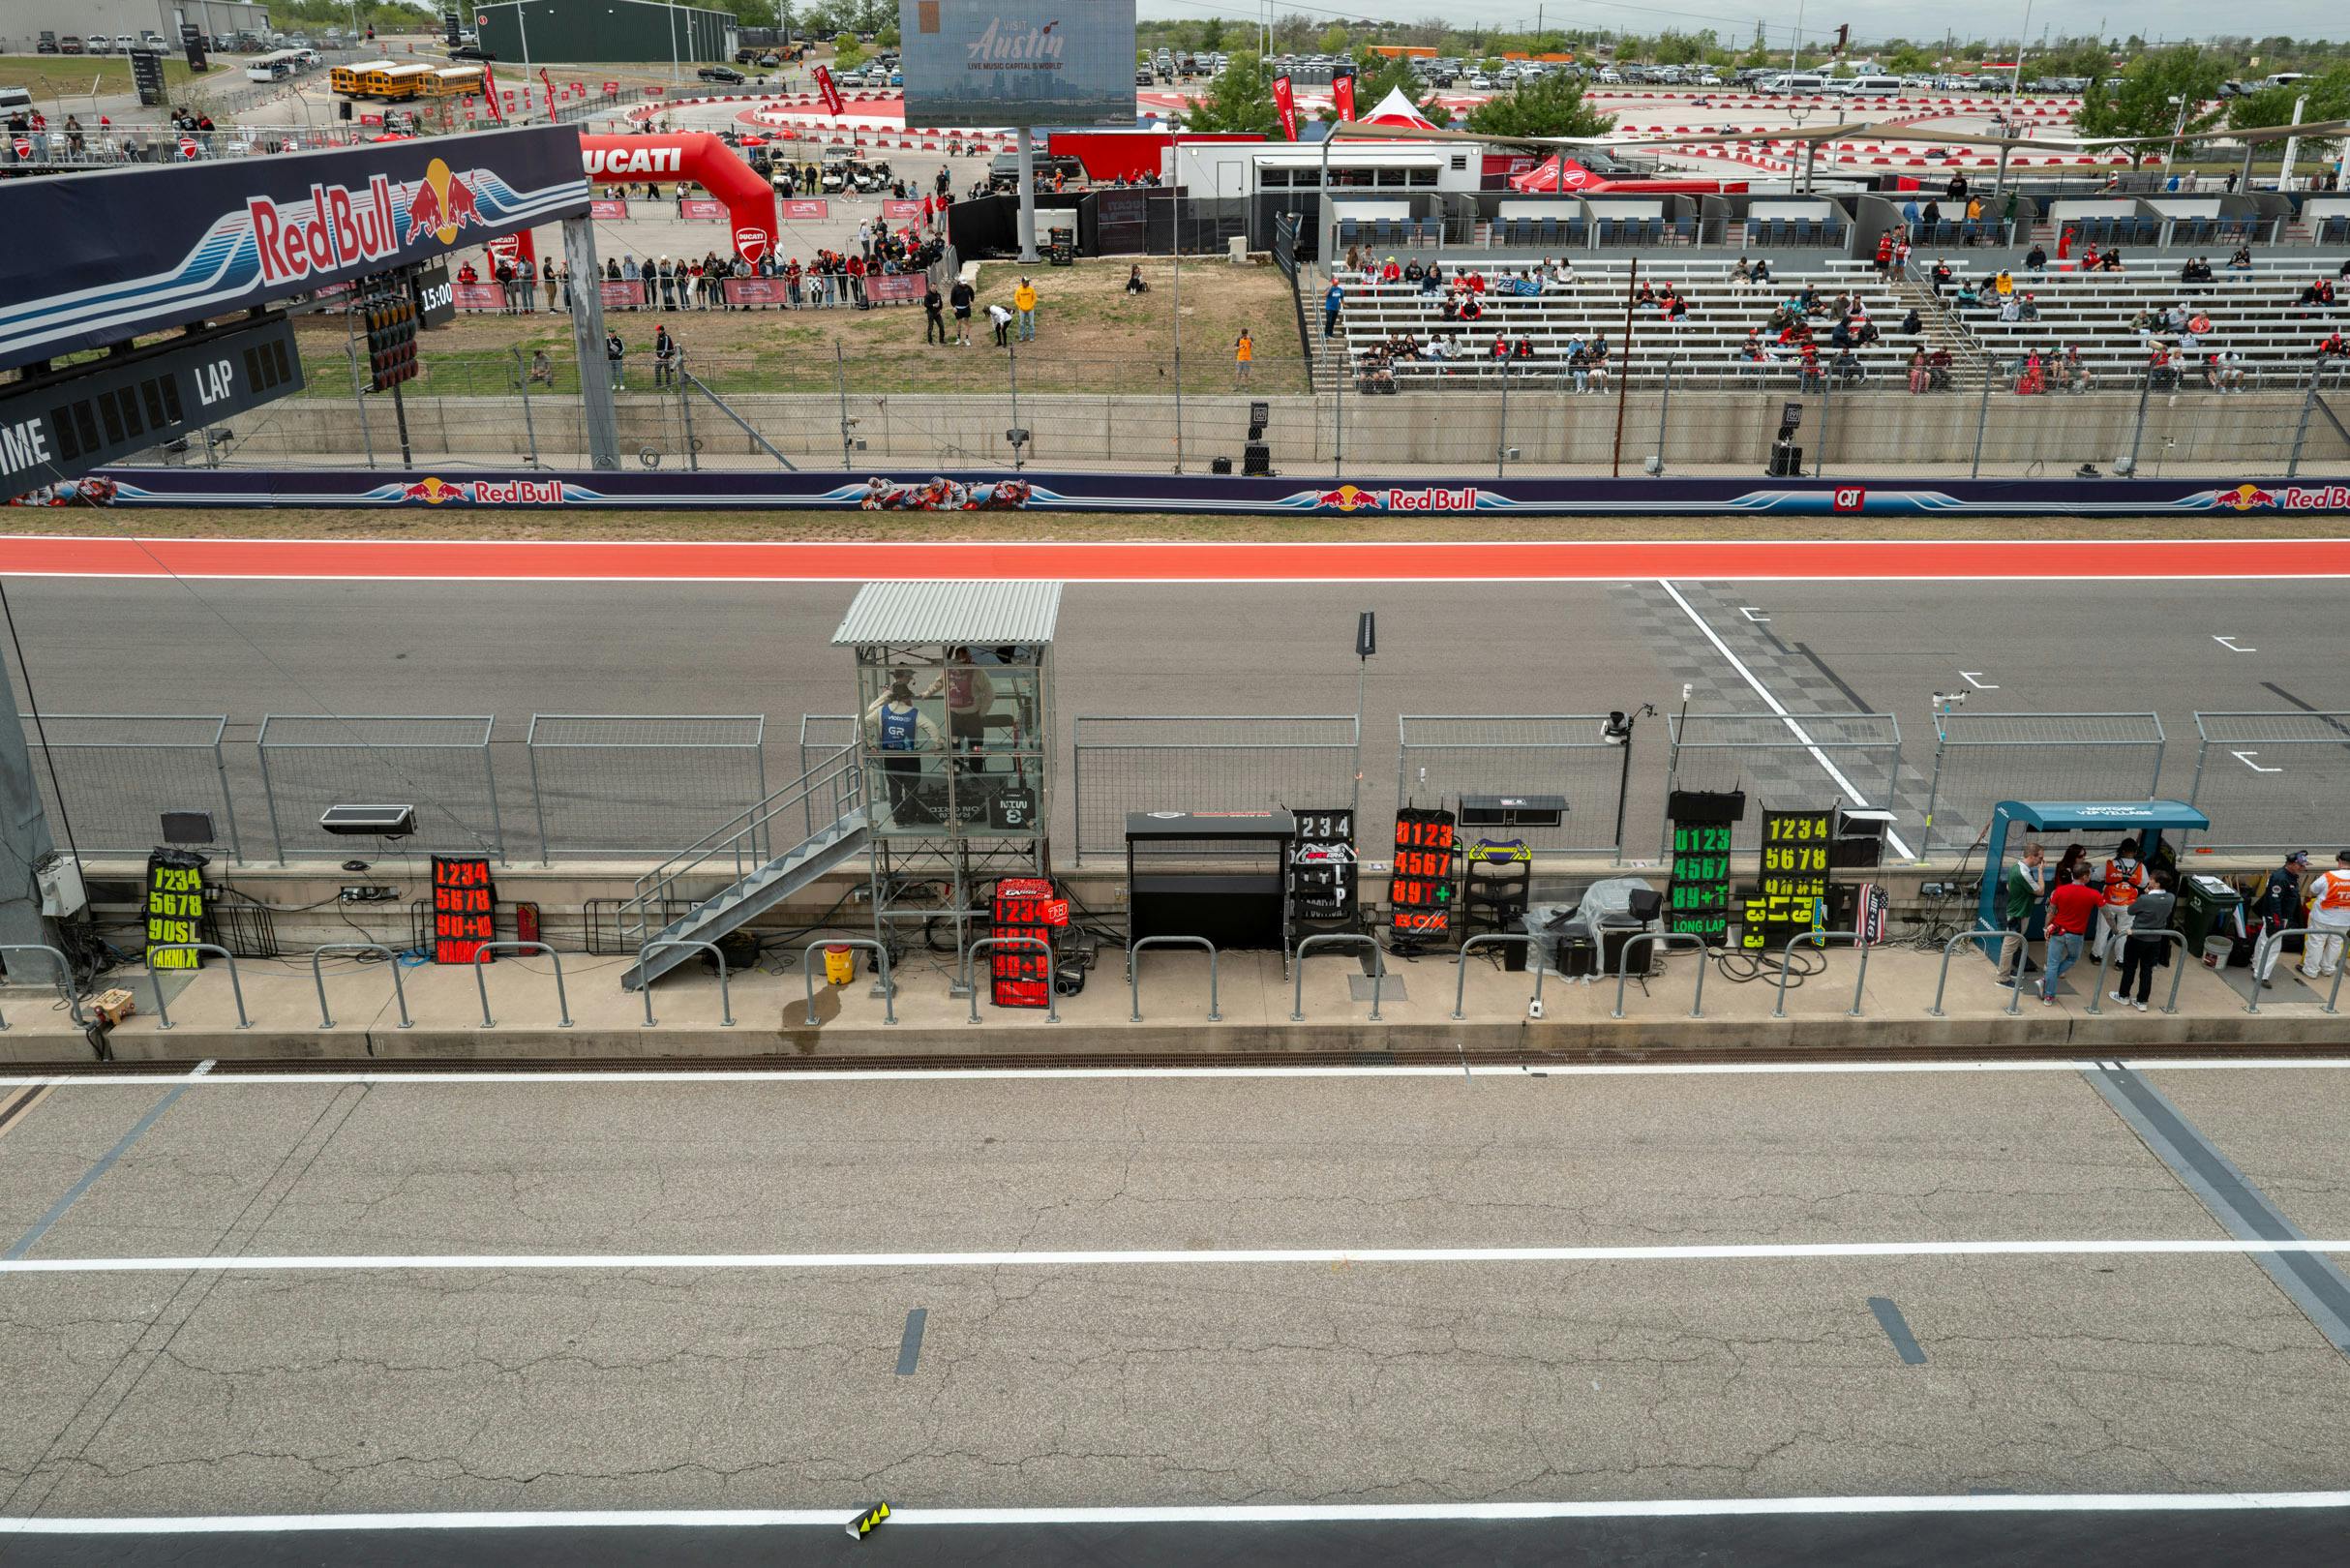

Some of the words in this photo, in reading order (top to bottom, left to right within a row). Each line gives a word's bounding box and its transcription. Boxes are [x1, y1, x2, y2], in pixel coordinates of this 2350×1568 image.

[967, 16, 1064, 60] Austin
[823, 83, 838, 111] PARKING
[582, 148, 681, 174] UCATI
[250, 187, 337, 281] Red
[328, 177, 397, 264] Bull
[421, 282, 453, 313] 15:00
[195, 359, 233, 406] LAP
[473, 480, 520, 503] Red
[520, 480, 564, 503] Bull
[1388, 487, 1432, 511] Red
[1433, 487, 1477, 511] Bull
[1837, 490, 1860, 507] QT
[2283, 486, 2333, 510] Red
[889, 726, 905, 736] GR
[1000, 800, 1028, 809] MIN
[1007, 809, 1022, 824] 3
[1396, 821, 1454, 847] 0123
[1674, 828, 1732, 852] 0123
[1769, 819, 1827, 840] 1234
[1394, 852, 1450, 877] 4567
[1673, 858, 1729, 881] 4567
[1765, 848, 1826, 871] 5678
[155, 867, 201, 890] 1234
[437, 860, 489, 886] 1234
[149, 891, 202, 917] 5678
[437, 888, 491, 912] 5678
[1792, 896, 1813, 923] P9
[1869, 893, 1879, 915] JOE
[148, 918, 201, 943] 90SL
[1395, 914, 1448, 929] BOX
[1673, 920, 1702, 933] LONG
[1705, 920, 1726, 933] LAP
